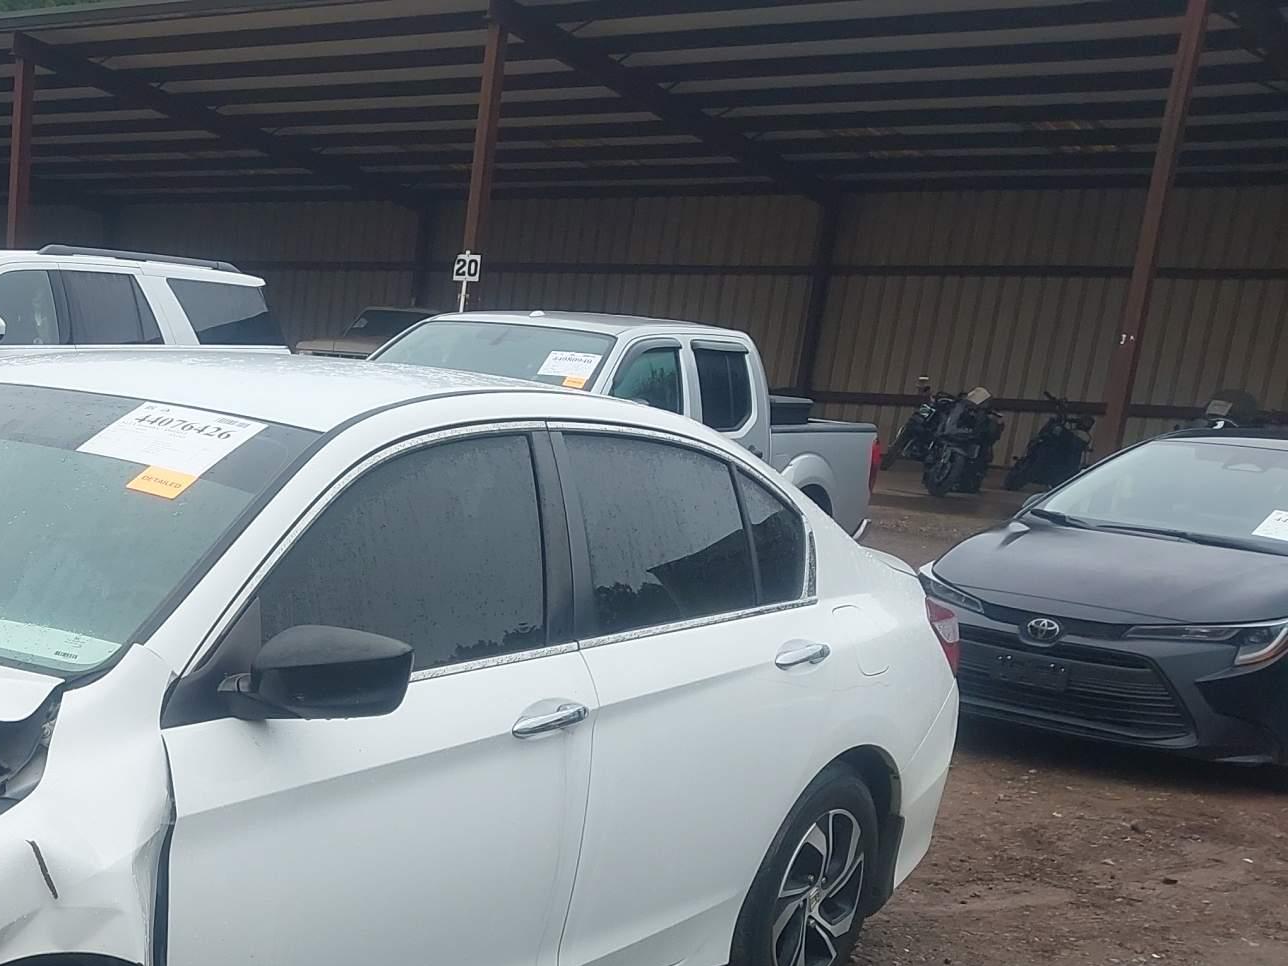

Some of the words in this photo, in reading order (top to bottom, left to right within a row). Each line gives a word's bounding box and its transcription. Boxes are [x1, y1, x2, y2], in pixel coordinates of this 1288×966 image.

[455, 258, 479, 277] 20
[135, 414, 232, 440] 44076426
[141, 475, 182, 489] DETAILED
